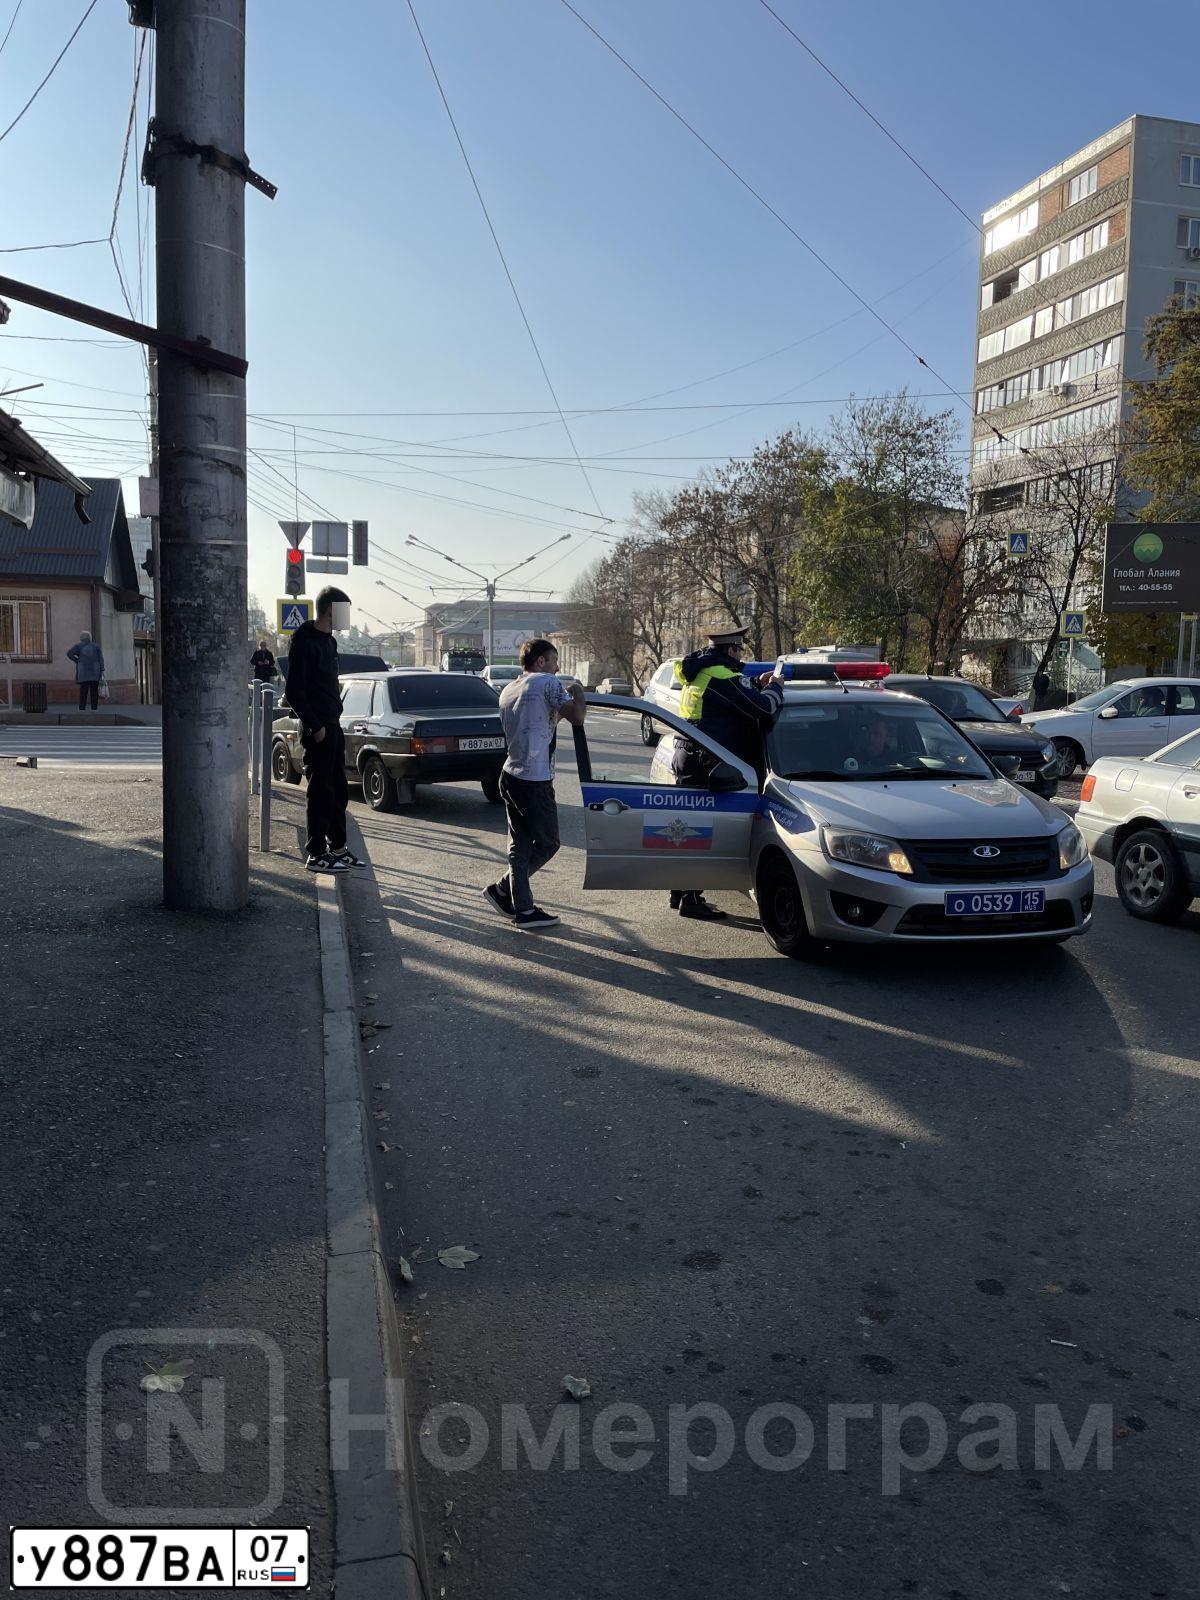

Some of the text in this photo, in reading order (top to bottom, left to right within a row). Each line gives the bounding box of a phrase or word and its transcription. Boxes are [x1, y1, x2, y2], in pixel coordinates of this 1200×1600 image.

[1113, 567, 1181, 578] Глобал Алания
[1138, 583, 1173, 591] 40-55-55
[643, 793, 715, 808] ПОЛИЦИЯ
[971, 894, 1014, 912] 0539
[1024, 891, 1040, 905] 15
